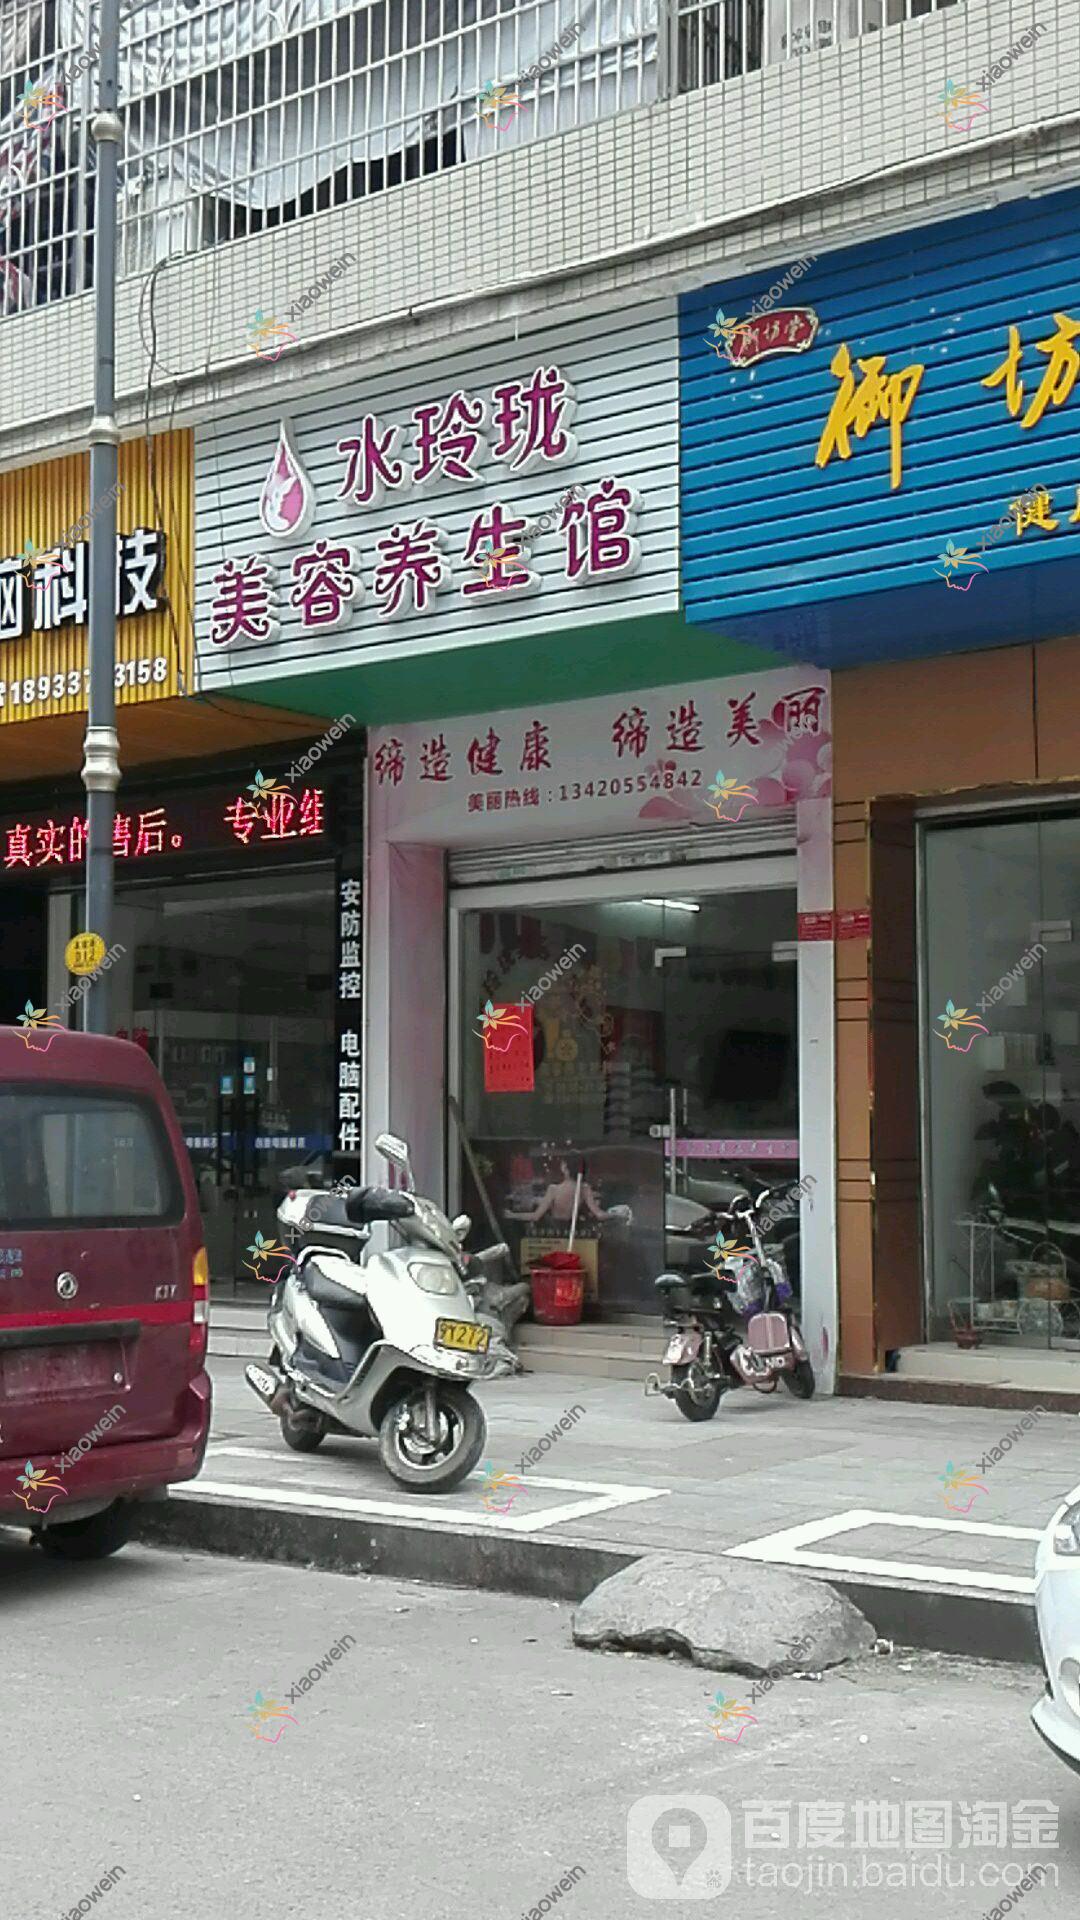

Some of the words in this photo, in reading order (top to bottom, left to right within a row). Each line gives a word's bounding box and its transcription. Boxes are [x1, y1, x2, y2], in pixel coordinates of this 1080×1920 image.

[337, 366, 572, 506] 水玲珑
[210, 478, 634, 647] 美容养生馆
[10, 656, 168, 706] 189333158
[374, 721, 553, 787] 缔造健康
[612, 686, 826, 759] 缔造美丽
[339, 879, 362, 999] 安防监控
[338, 1029, 362, 1152] 电脑配件
